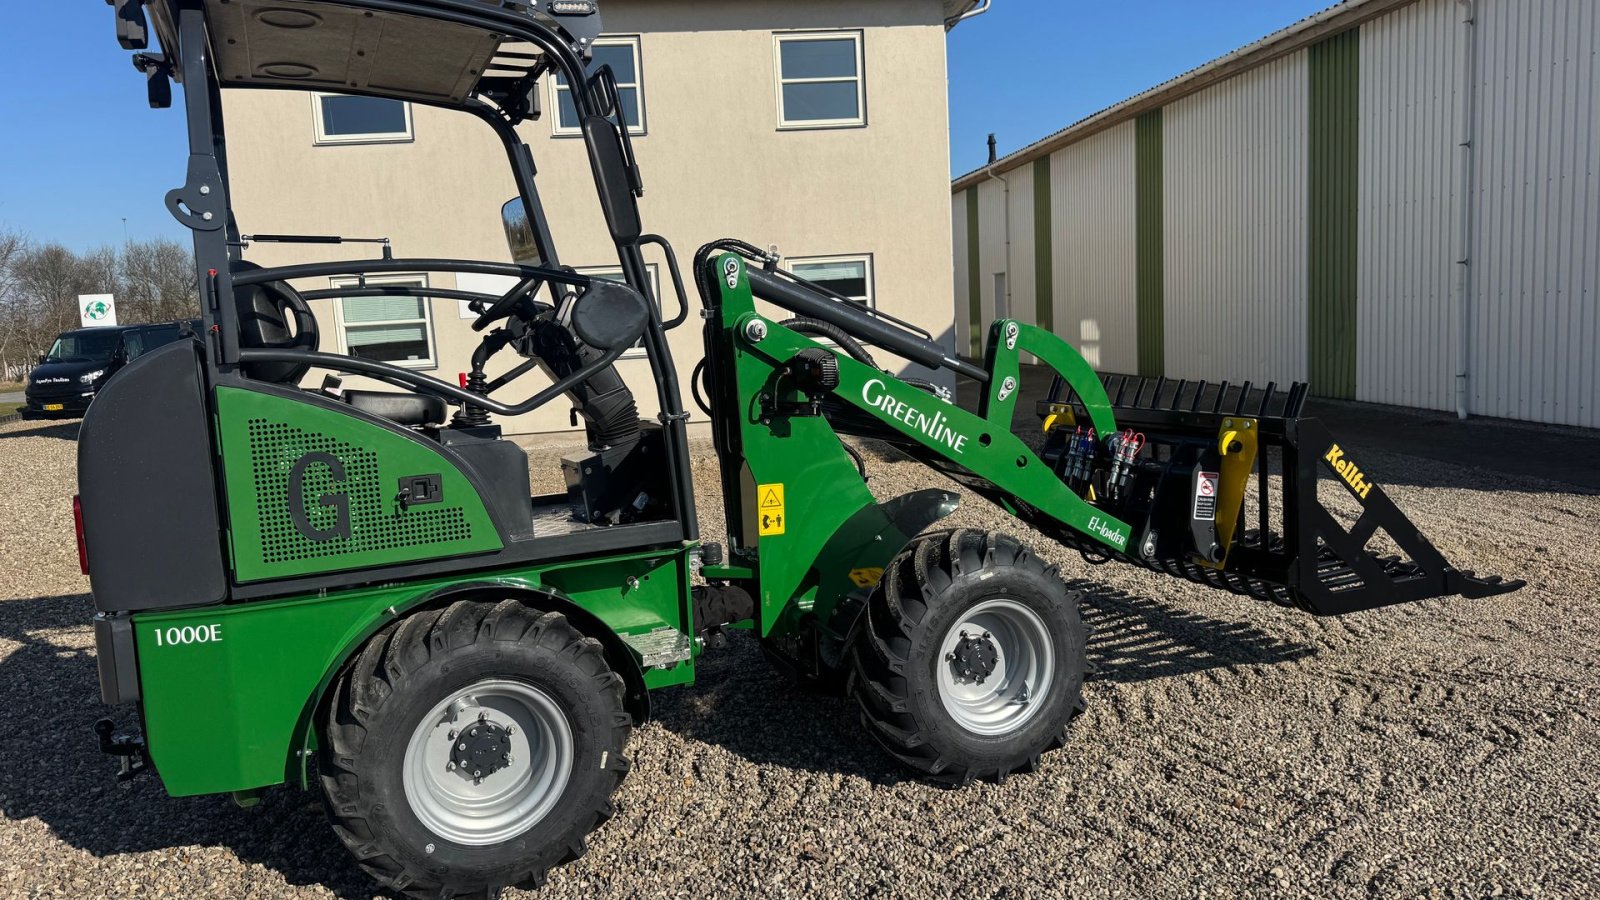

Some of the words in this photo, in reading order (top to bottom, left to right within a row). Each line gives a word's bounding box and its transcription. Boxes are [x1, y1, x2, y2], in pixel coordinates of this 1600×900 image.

[288, 451, 352, 542] G
[1325, 443, 1373, 500] Kellfri
[154, 624, 223, 646] 1000E
